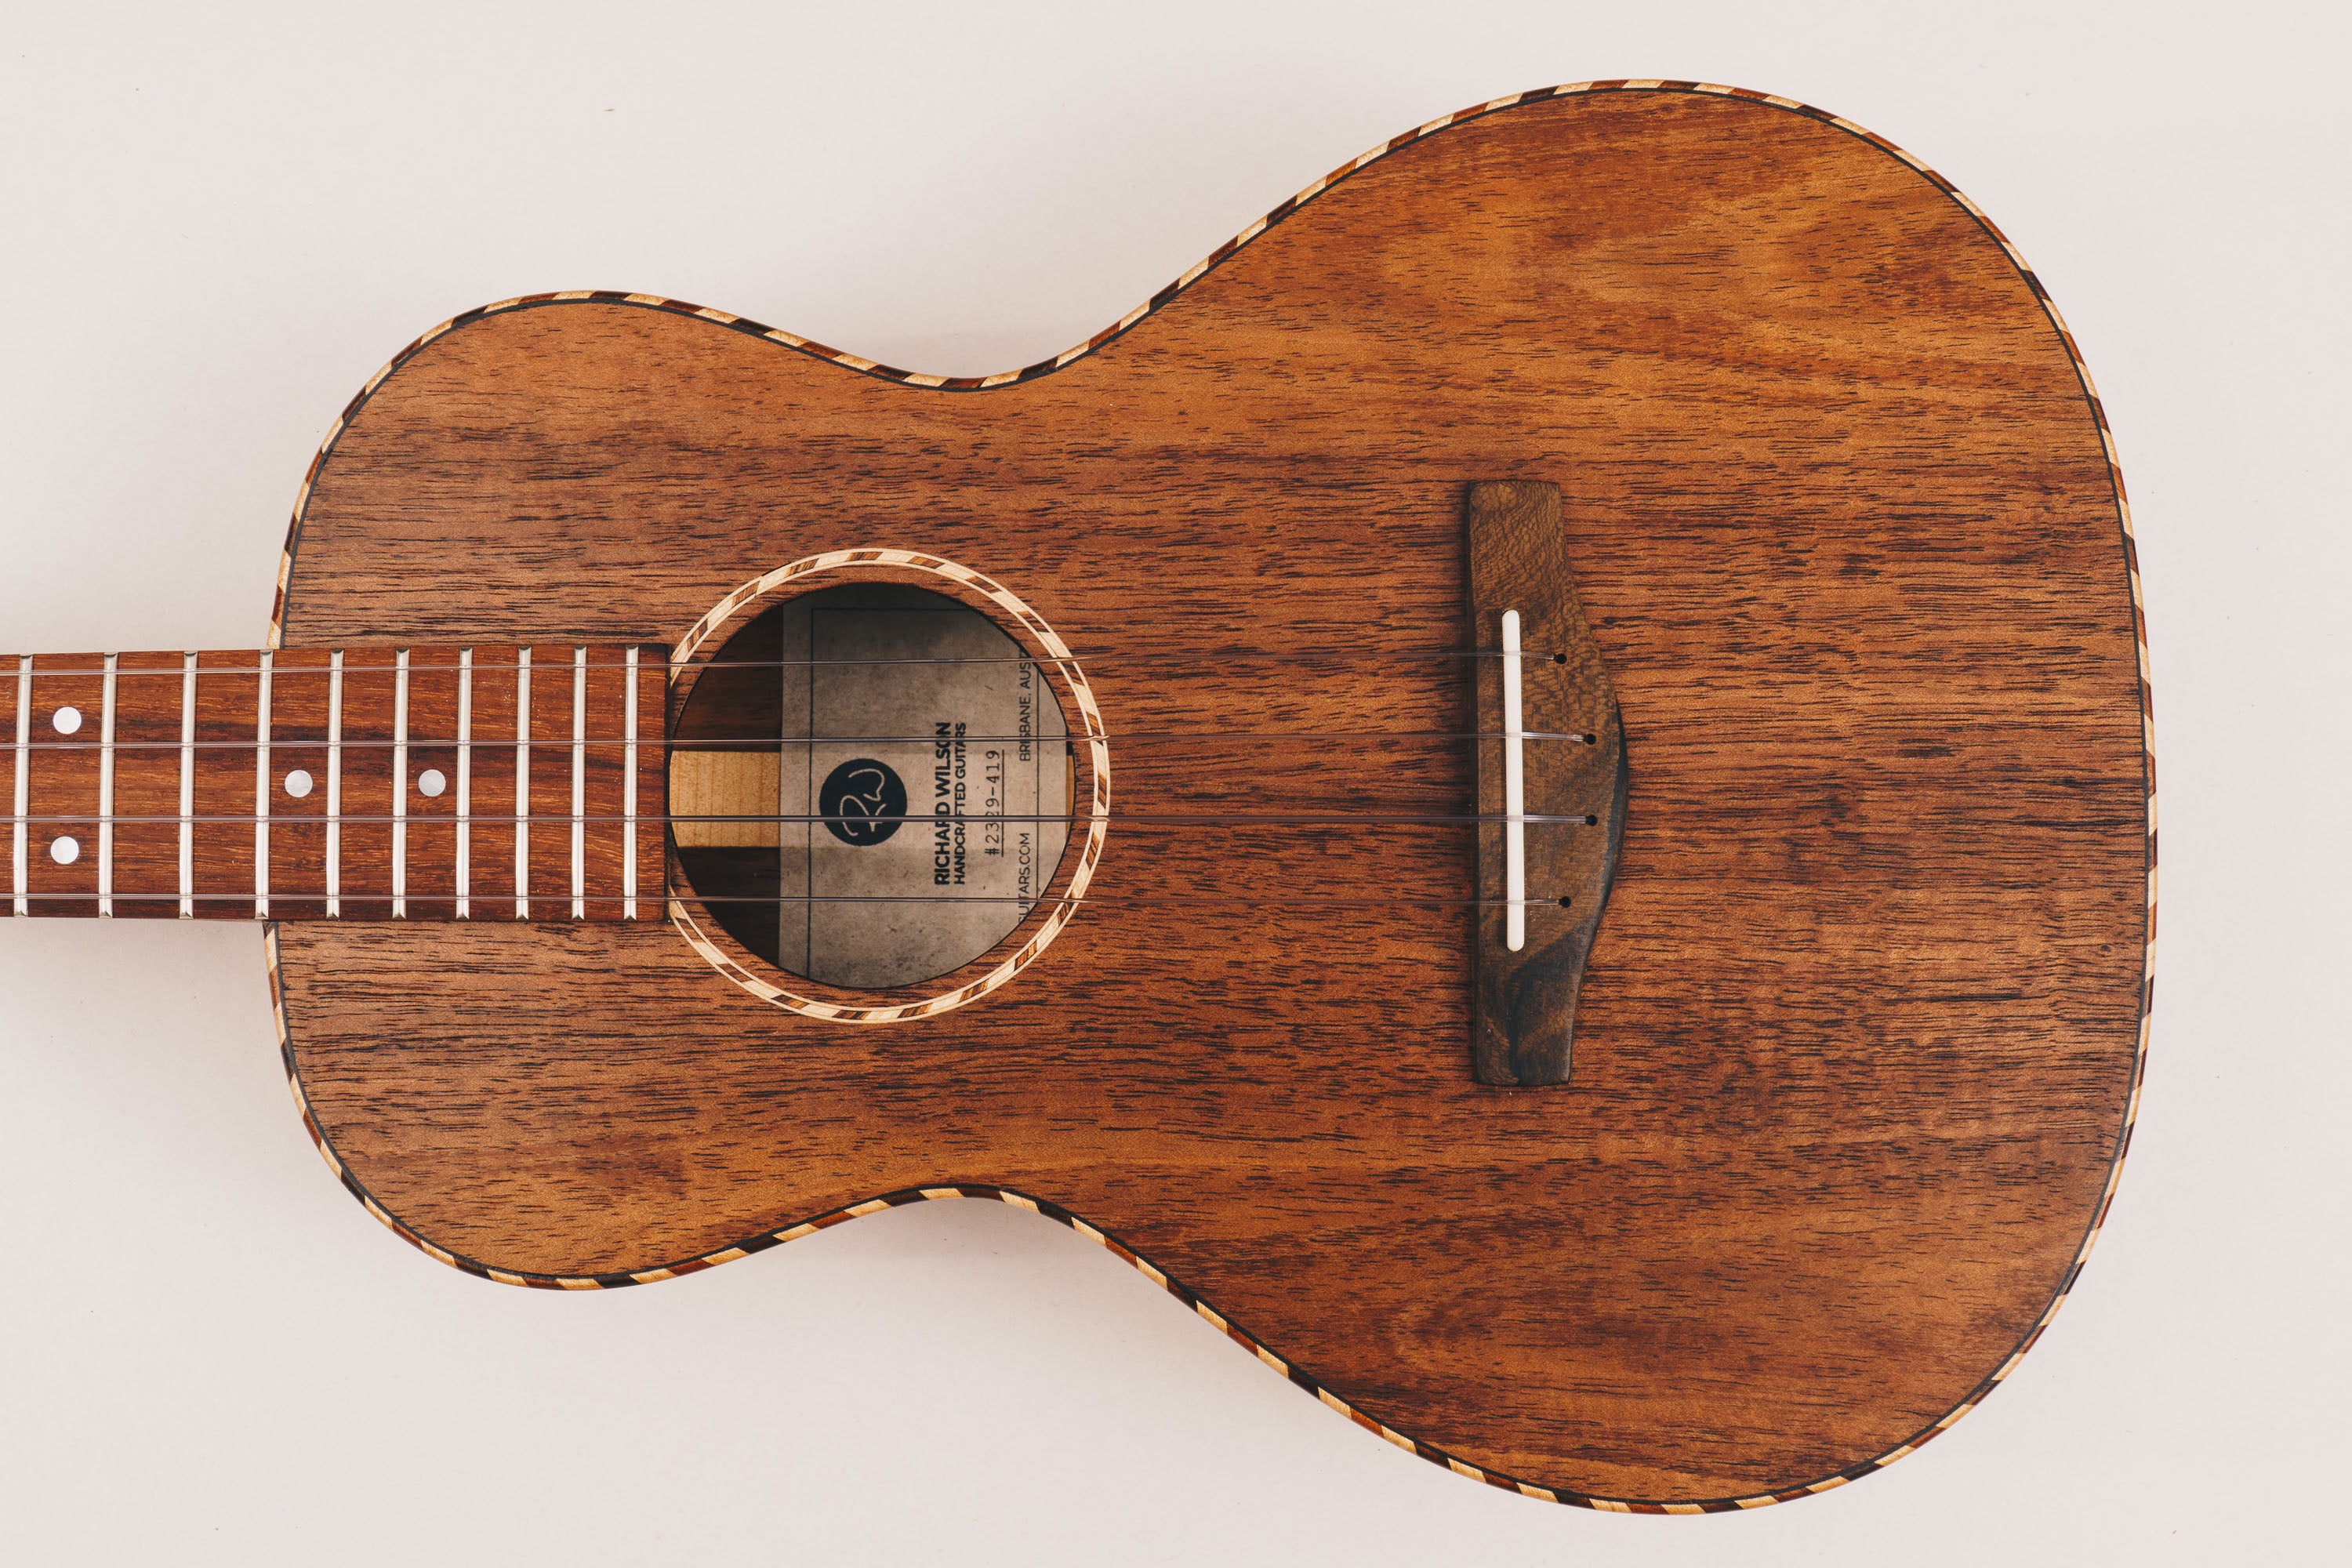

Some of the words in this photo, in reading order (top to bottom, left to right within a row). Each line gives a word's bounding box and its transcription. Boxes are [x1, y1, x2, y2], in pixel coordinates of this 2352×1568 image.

[935, 722, 951, 797] WILSON
[954, 722, 967, 779] GUITARS
[1019, 693, 1032, 761] BRISBANE,
[934, 801, 951, 886] RICHARD
[953, 782, 966, 884] HANDCRAFTED
